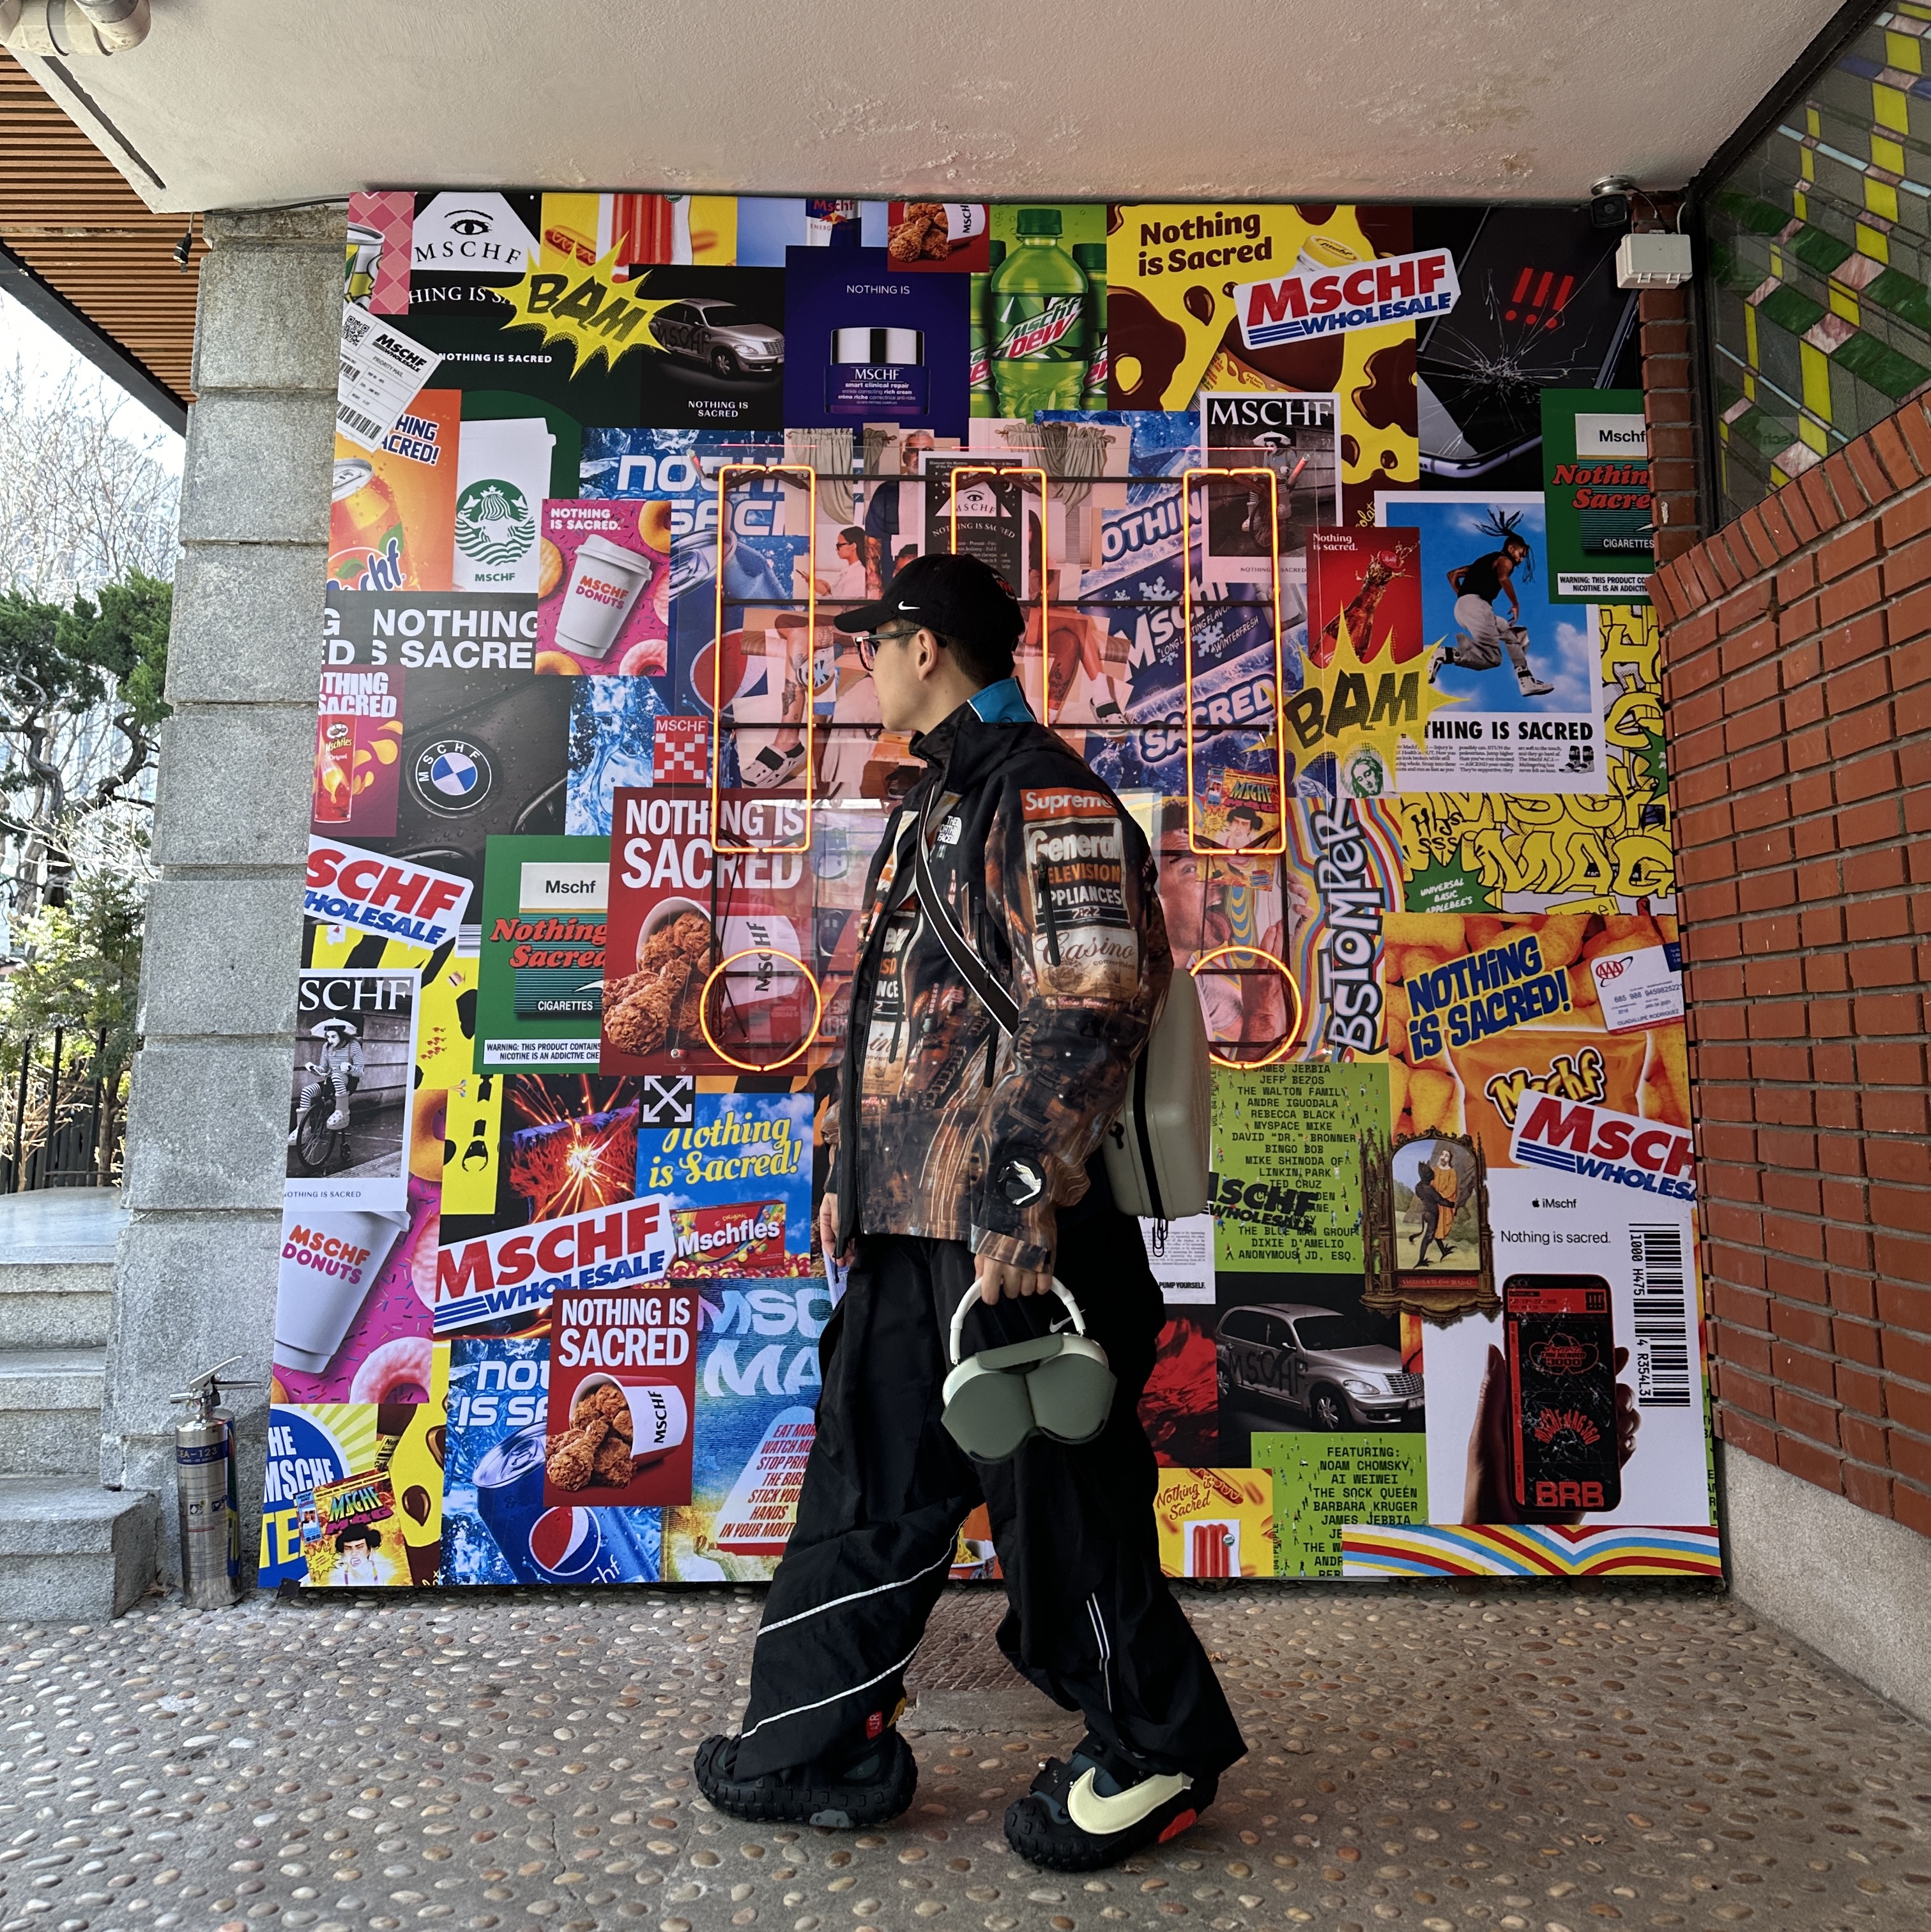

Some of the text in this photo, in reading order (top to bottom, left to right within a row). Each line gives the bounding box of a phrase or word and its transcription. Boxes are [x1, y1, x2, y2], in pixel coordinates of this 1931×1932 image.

[1141, 211, 1260, 247] Nothing
[414, 241, 521, 264] MSCHF
[1139, 236, 1272, 277] is Sacred
[846, 285, 910, 294] NOTHING IS
[1246, 255, 1446, 326] MSCHF
[527, 273, 648, 342] BAM
[1302, 292, 1451, 335] WHOLESALE
[375, 333, 427, 367] MSCHF
[383, 348, 421, 372] WHOLESALE
[439, 353, 552, 363] NOTHING IS SACRED
[372, 356, 403, 377] PRIORITY MAIL
[855, 369, 900, 380] MSCHF
[689, 400, 735, 409] NOTHING
[698, 409, 738, 418] SACRED
[1211, 400, 1331, 425] MSCHF
[1599, 430, 1646, 443] Mschf
[551, 508, 611, 519] NOTHING
[551, 520, 622, 531] IS SACRED.
[1313, 533, 1352, 544] Nothing
[1603, 539, 1654, 549] CIGARETTES
[1323, 543, 1359, 551] sacred.
[475, 572, 515, 582] MSCHF
[579, 575, 629, 600] MSCHF
[576, 585, 625, 610] DONUTS
[373, 609, 538, 638] NOTHING
[1213, 615, 1260, 653] WINTERFRESH
[317, 694, 397, 718] SACRED
[1284, 668, 1420, 749] BAM
[656, 720, 706, 732] MSCHF
[1492, 722, 1593, 740] IS SACRED
[1025, 791, 1113, 814] Supreme
[947, 816, 958, 825] THE
[937, 833, 954, 844] FACE
[1028, 830, 1121, 865] General
[622, 838, 804, 889] SACRED
[1034, 862, 1122, 884] ELEVISION
[546, 880, 596, 894] Mschf
[1419, 878, 1465, 896] UNIVERSAL
[1434, 890, 1459, 903] BASIC
[1424, 896, 1474, 913] APPLEBEE'S
[489, 918, 607, 946] Nothing
[1035, 931, 1135, 966] Casino
[538, 1001, 593, 1011] CIGARETTES
[1447, 969, 1572, 1047] SACRED!
[1649, 1008, 1680, 1020] RODRIGUEZ
[487, 1043, 569, 1052] WARNING: THIS PRODUCT
[500, 1052, 585, 1060] NICOTINE ADDICTIVE
[1292, 1065, 1331, 1074] JEBBIA
[1260, 1076, 1325, 1084] JEFF BEZOS
[1237, 1087, 1346, 1097] THE WALTON FAMILY
[1248, 1099, 1339, 1108] ANDRE IGUODALA
[1251, 1110, 1336, 1119] REBECCA BLACK
[1254, 1122, 1332, 1130] MYSPACE MIKE
[1232, 1133, 1356, 1143] DAVID BRONNER
[1265, 1145, 1324, 1153] BINGO BOB
[649, 1139, 802, 1188] is Sacred!
[1245, 1156, 1324, 1166] MIKE SHINODA
[1259, 1168, 1331, 1178] LINKIN PARK
[1295, 1180, 1322, 1189] CRUZ
[1542, 1198, 1577, 1209] iMschf
[1239, 1226, 1356, 1237] THE BLUE MAN GROUP
[1501, 1230, 1611, 1245] Nothing is sacred.
[288, 1224, 371, 1266] MSCHF
[677, 1221, 781, 1259] Mschfles
[1251, 1238, 1344, 1249] DIXIE D'AMELIO
[435, 1202, 660, 1303] MSCHF
[1630, 1234, 1644, 1262] 1000
[1238, 1250, 1356, 1262] ANONYMOUS JD, ESQ.
[281, 1242, 363, 1285] DONUTS
[484, 1249, 666, 1314] WHOLESALE
[1633, 1268, 1645, 1296] H475
[561, 1297, 691, 1327] NOTHING IS
[558, 1327, 690, 1367] SACRED
[1637, 1353, 1651, 1397] R354L3
[457, 1397, 498, 1427] IS
[648, 1390, 668, 1444] MSCHF
[773, 1424, 794, 1437] EAT
[761, 1440, 797, 1454] WATCH
[1327, 1447, 1401, 1457] FEATURING:
[756, 1457, 785, 1470] STOP
[1319, 1460, 1409, 1471] NOAM CHOMSKY
[1331, 1474, 1398, 1485] AI WEIWEI
[748, 1489, 779, 1503] STICK
[1313, 1487, 1418, 1499] THE SOCK QUEEN
[1536, 1481, 1605, 1507] BRB
[749, 1505, 788, 1520] HANDS
[1313, 1502, 1418, 1512] BARBARA KRUGER
[1321, 1515, 1410, 1525] JAMES JEBBIA
[719, 1523, 759, 1538] IN YOUR
[1304, 1542, 1325, 1553] THE
